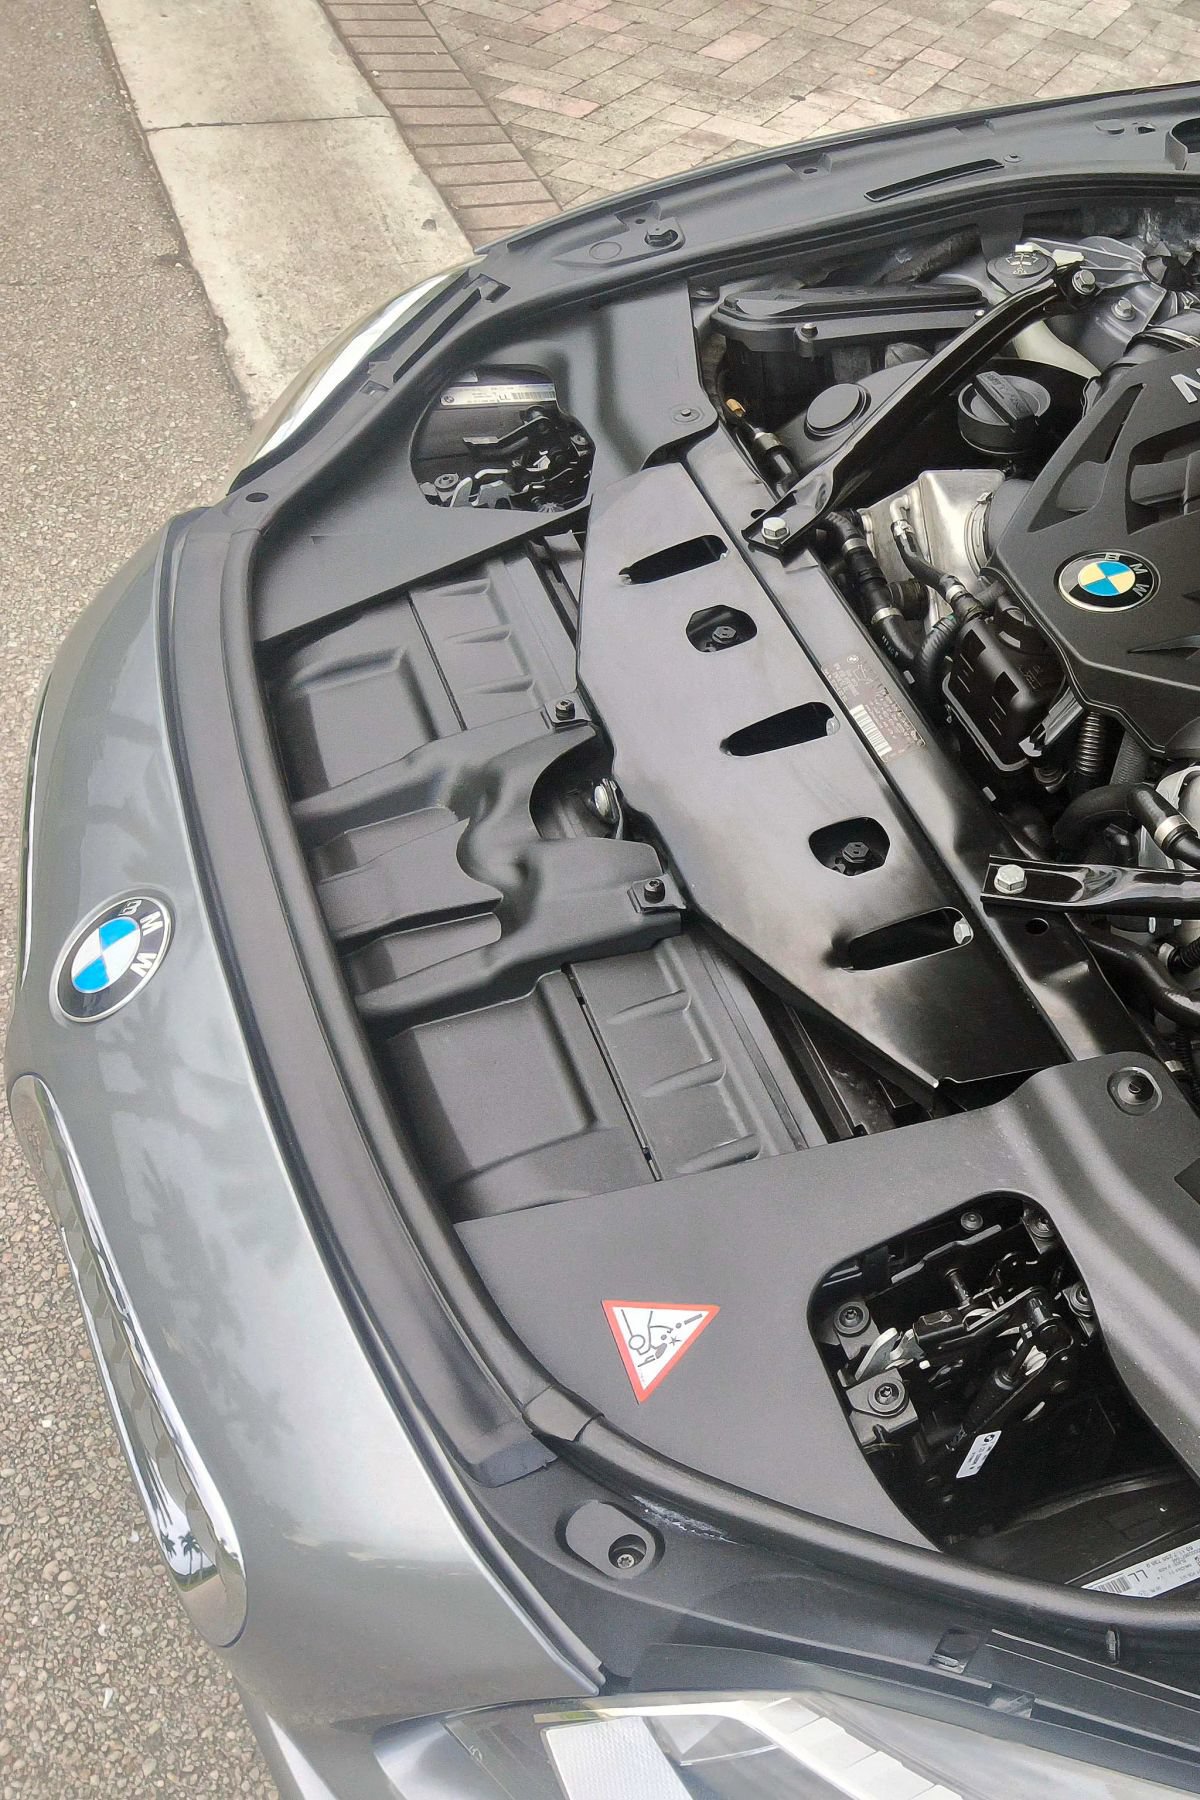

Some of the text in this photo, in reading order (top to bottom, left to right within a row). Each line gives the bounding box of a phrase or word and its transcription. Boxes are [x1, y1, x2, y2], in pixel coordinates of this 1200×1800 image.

[1104, 553, 1150, 597] BMW
[118, 899, 164, 977] BMW
[1128, 1569, 1148, 1582] LL
